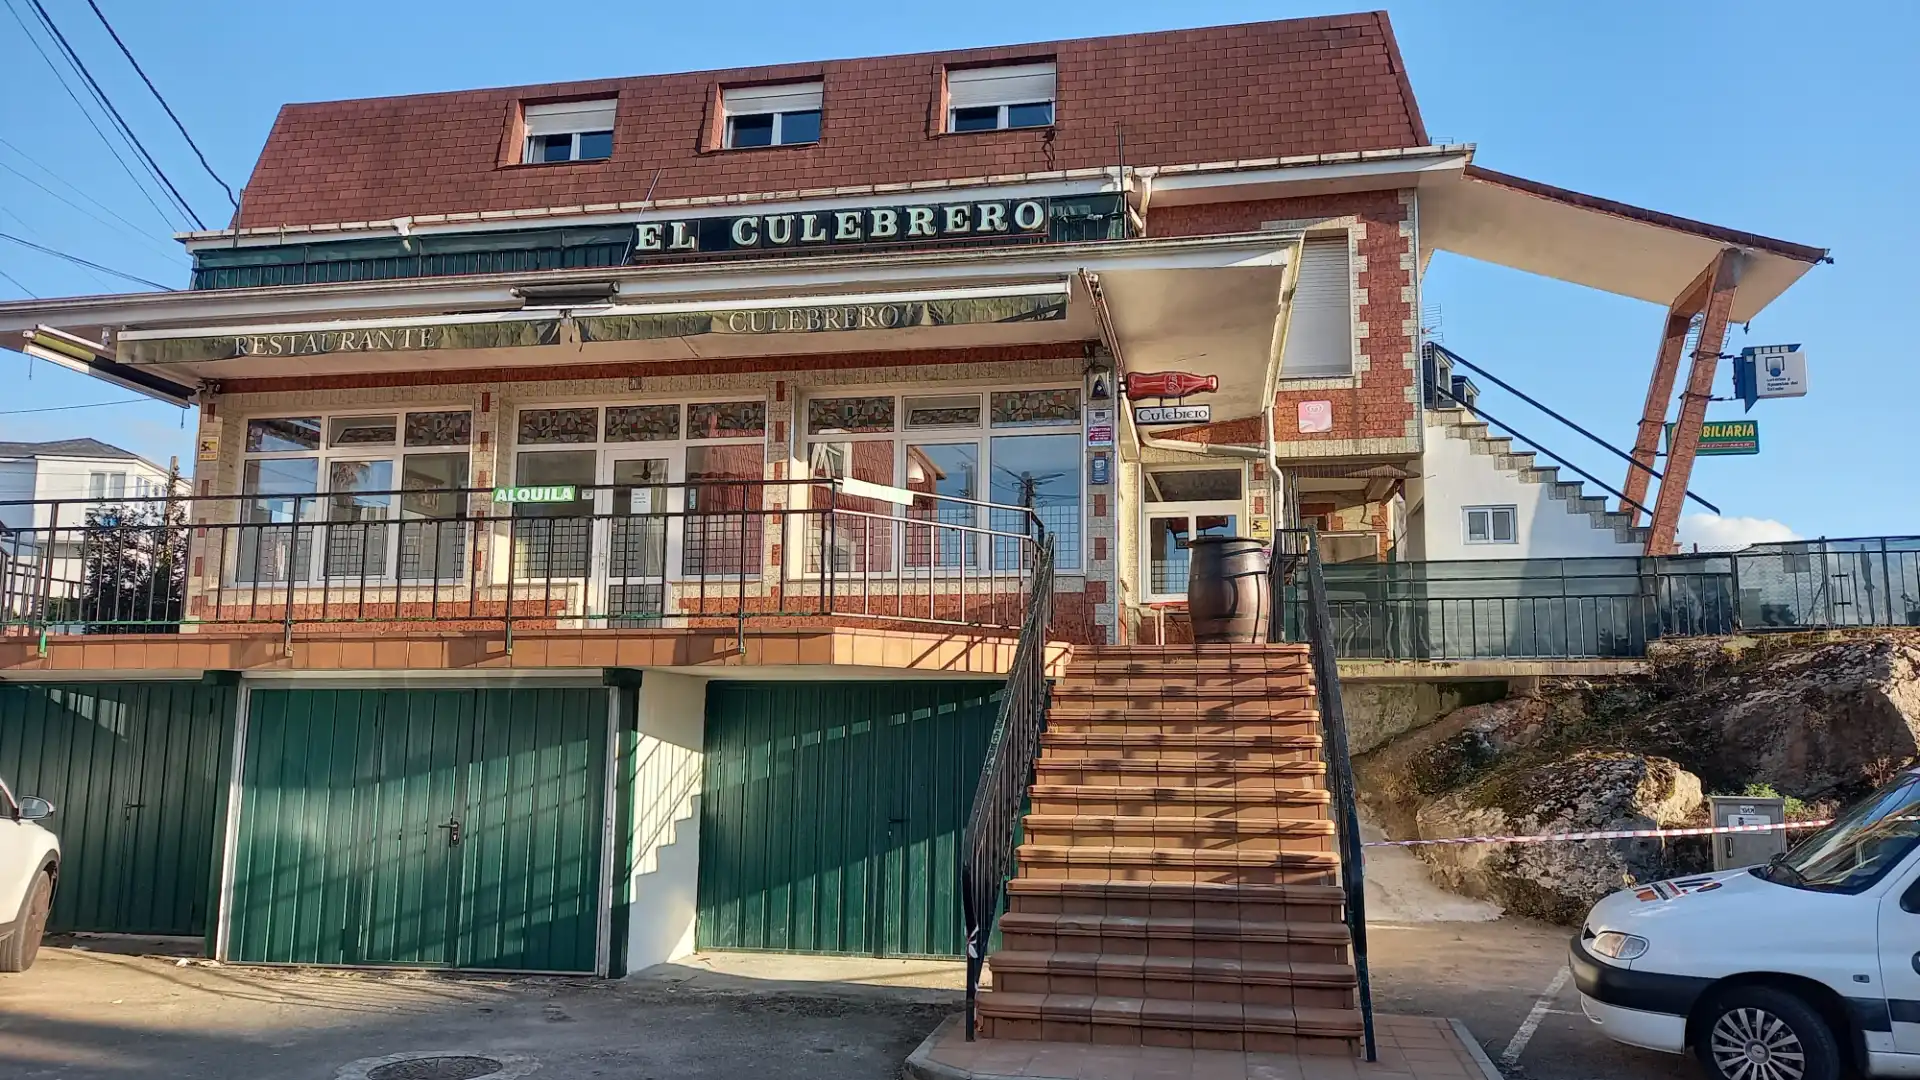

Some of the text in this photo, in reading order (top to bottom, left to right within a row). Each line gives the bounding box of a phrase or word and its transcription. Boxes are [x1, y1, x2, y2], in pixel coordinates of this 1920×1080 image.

[635, 201, 1045, 251] EL CULEBRERO
[729, 304, 899, 333] CULEBRERO
[234, 327, 436, 357] RESTAURANTE
[1671, 424, 1755, 439] BILIARIA
[494, 487, 573, 502] ALQUILA
